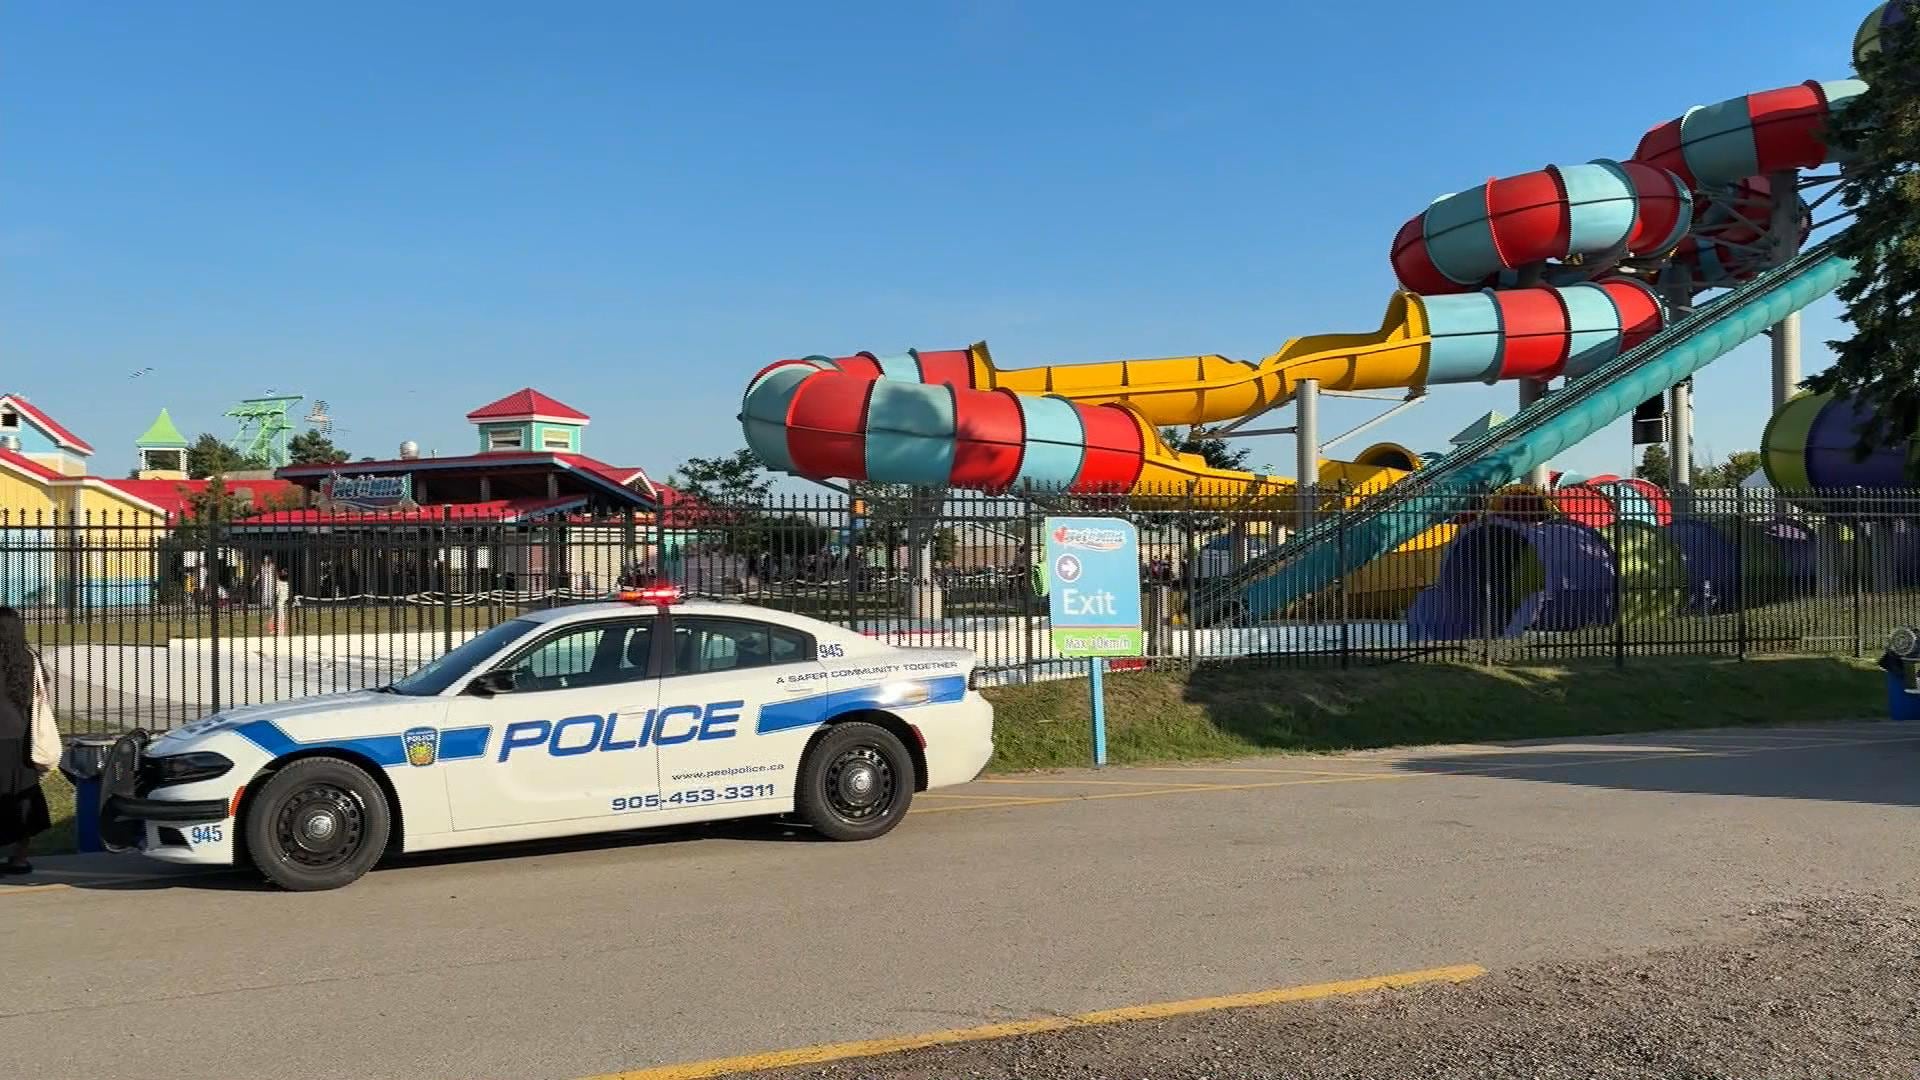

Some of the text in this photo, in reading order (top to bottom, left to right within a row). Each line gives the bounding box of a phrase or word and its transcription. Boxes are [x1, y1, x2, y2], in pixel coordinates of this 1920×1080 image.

[1063, 588, 1117, 616] Exit
[818, 643, 844, 659] 945
[1065, 636, 1086, 649] Max
[776, 661, 958, 685] A SAFER COMMUNITY TOGETHER
[497, 700, 745, 763] POLICE
[671, 763, 785, 781] www.peelpolice.ca
[611, 783, 775, 811] 905-453-3311
[191, 825, 223, 844] 945
